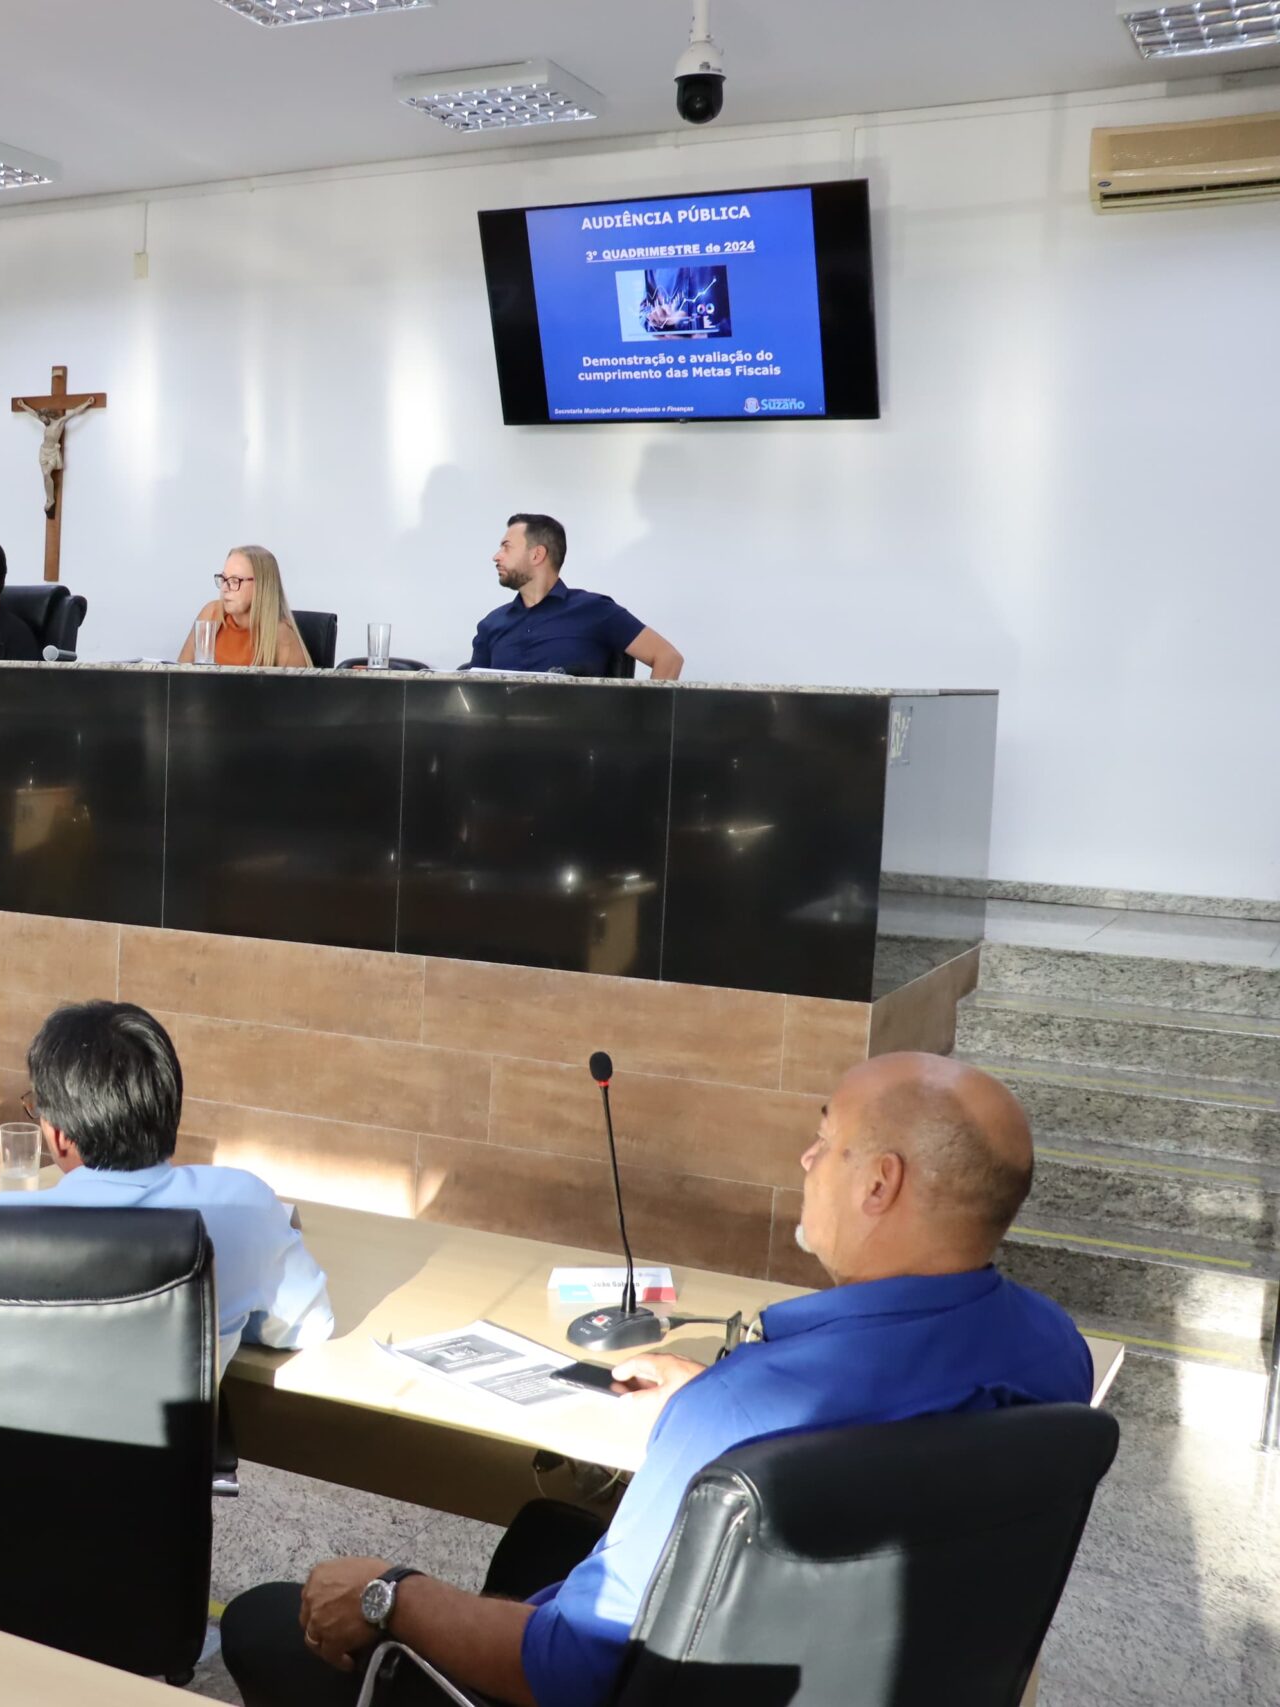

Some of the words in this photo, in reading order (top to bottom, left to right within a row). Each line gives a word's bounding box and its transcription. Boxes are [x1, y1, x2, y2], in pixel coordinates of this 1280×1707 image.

[581, 210, 673, 230] AUDIÊNCIA
[677, 205, 751, 223] PÚBLICA
[602, 244, 700, 260] QUADRIMESTRE
[705, 243, 720, 253] de
[724, 240, 755, 251] 2024
[582, 353, 674, 367] Demonstração
[678, 355, 686, 364] e
[690, 351, 752, 364] avaliação
[756, 350, 773, 361] do
[578, 367, 662, 382] cumprimento
[666, 367, 689, 378] das
[692, 366, 731, 377] Metas
[736, 364, 781, 376] Fiscais
[761, 399, 805, 410] Suzano
